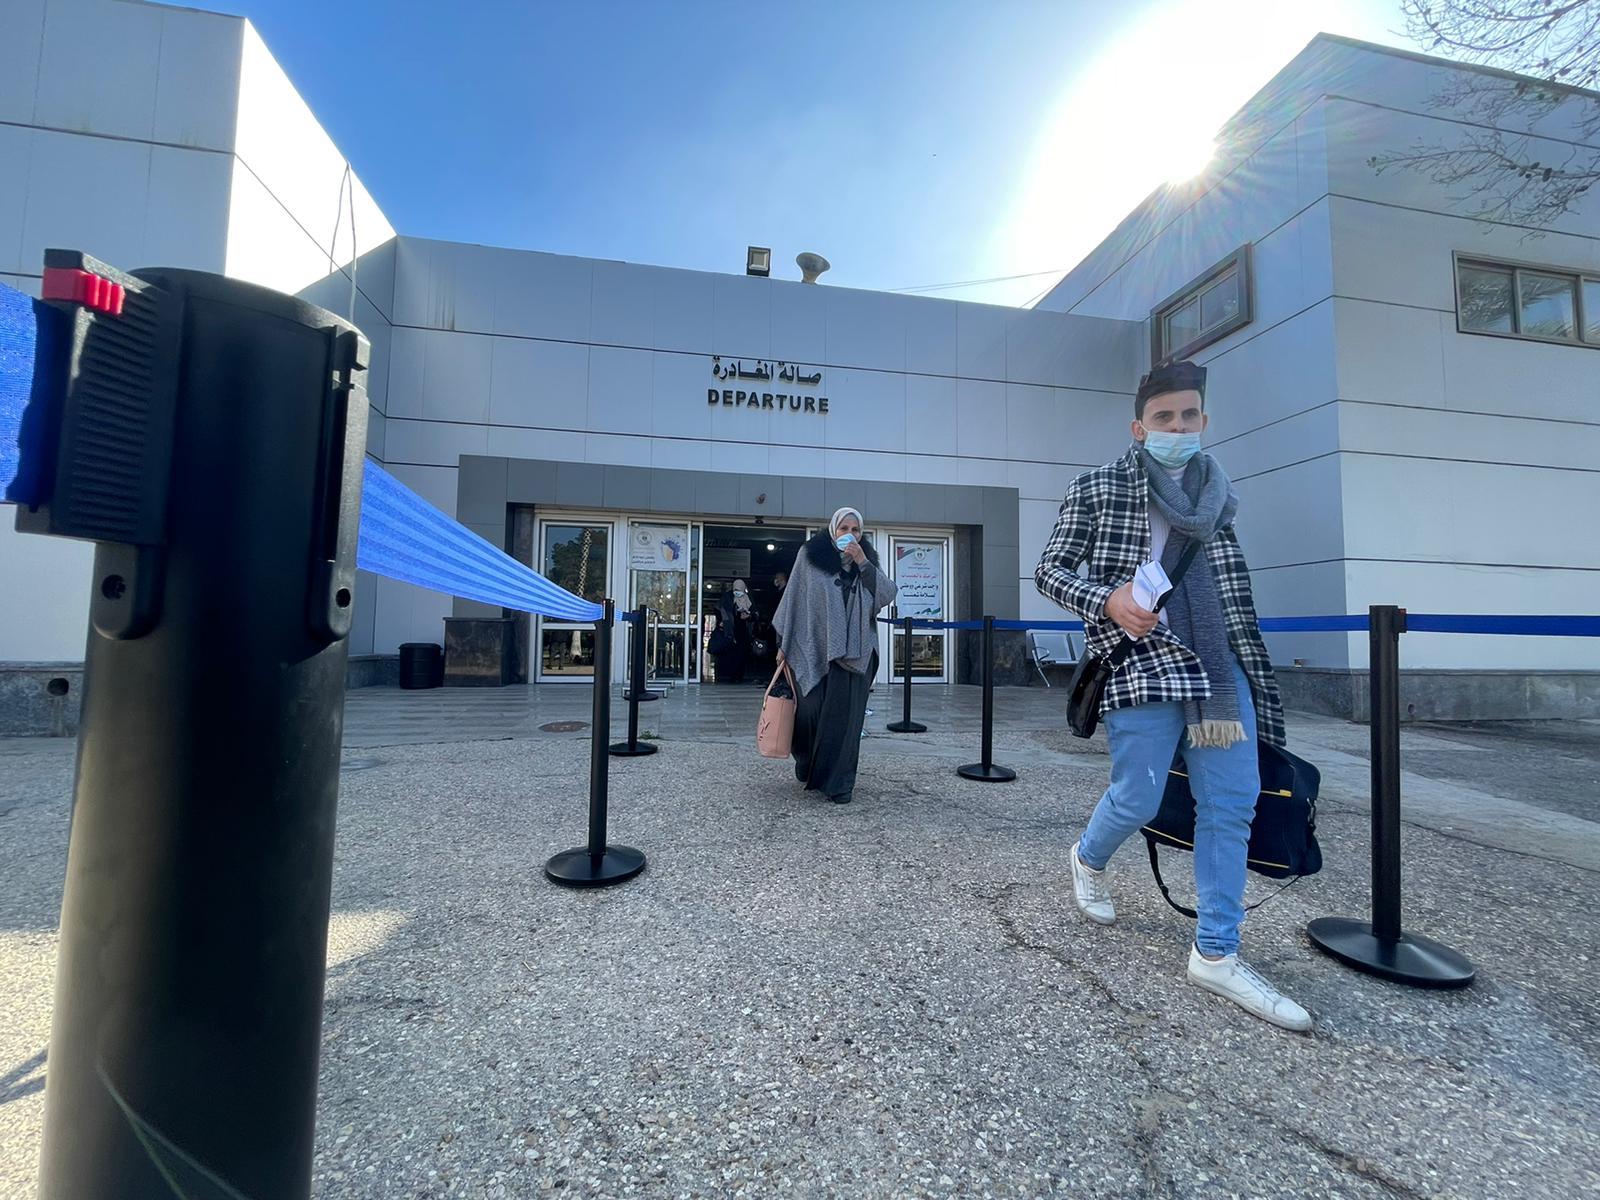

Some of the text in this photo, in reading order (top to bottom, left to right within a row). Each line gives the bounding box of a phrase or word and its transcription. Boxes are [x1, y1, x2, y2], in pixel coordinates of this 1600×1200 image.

[712, 355, 822, 384] صالة المغادرة
[708, 389, 829, 414] DEPARTURE
